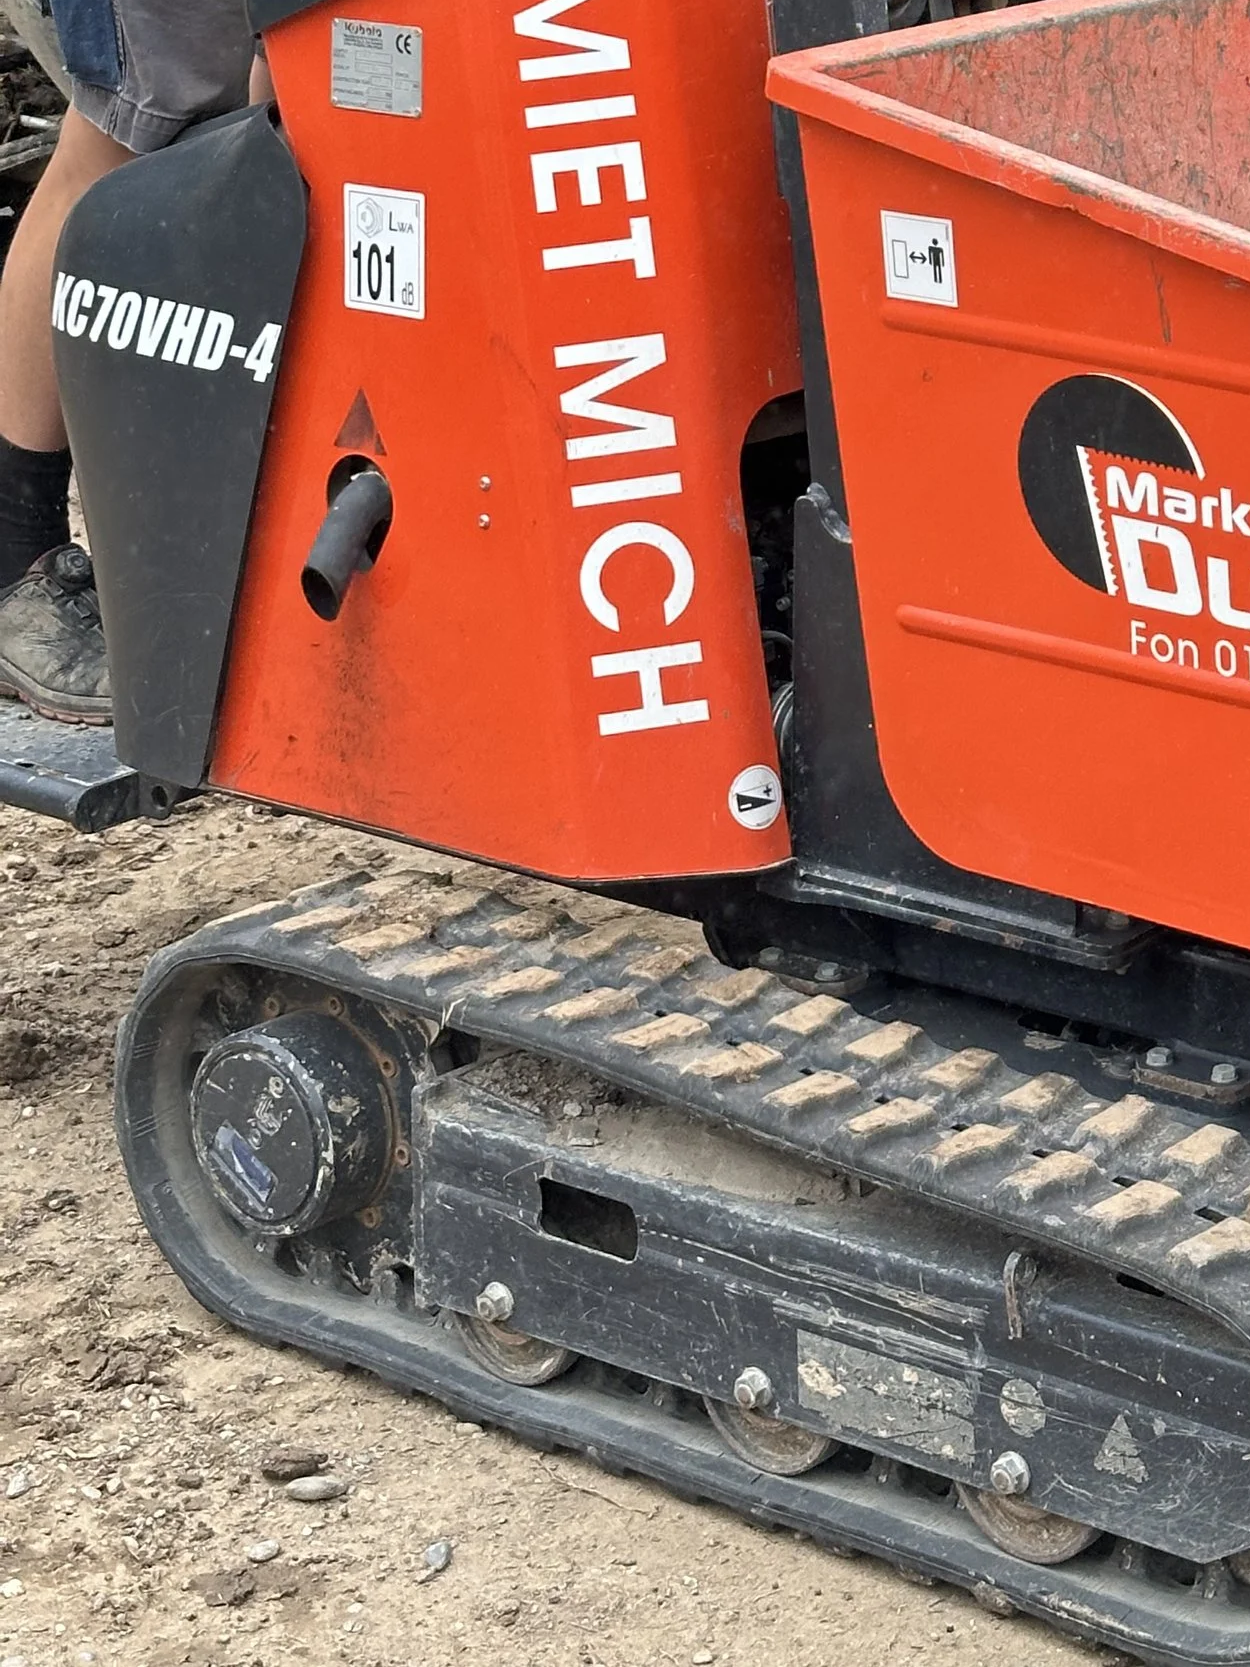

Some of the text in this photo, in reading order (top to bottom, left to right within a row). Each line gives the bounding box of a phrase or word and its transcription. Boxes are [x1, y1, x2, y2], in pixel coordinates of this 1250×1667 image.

[352, 240, 395, 303] 101
[402, 281, 415, 306] dB
[52, 271, 283, 383] KC70VHD-4
[553, 332, 710, 736] MICH
[1130, 619, 1200, 670] Fon
